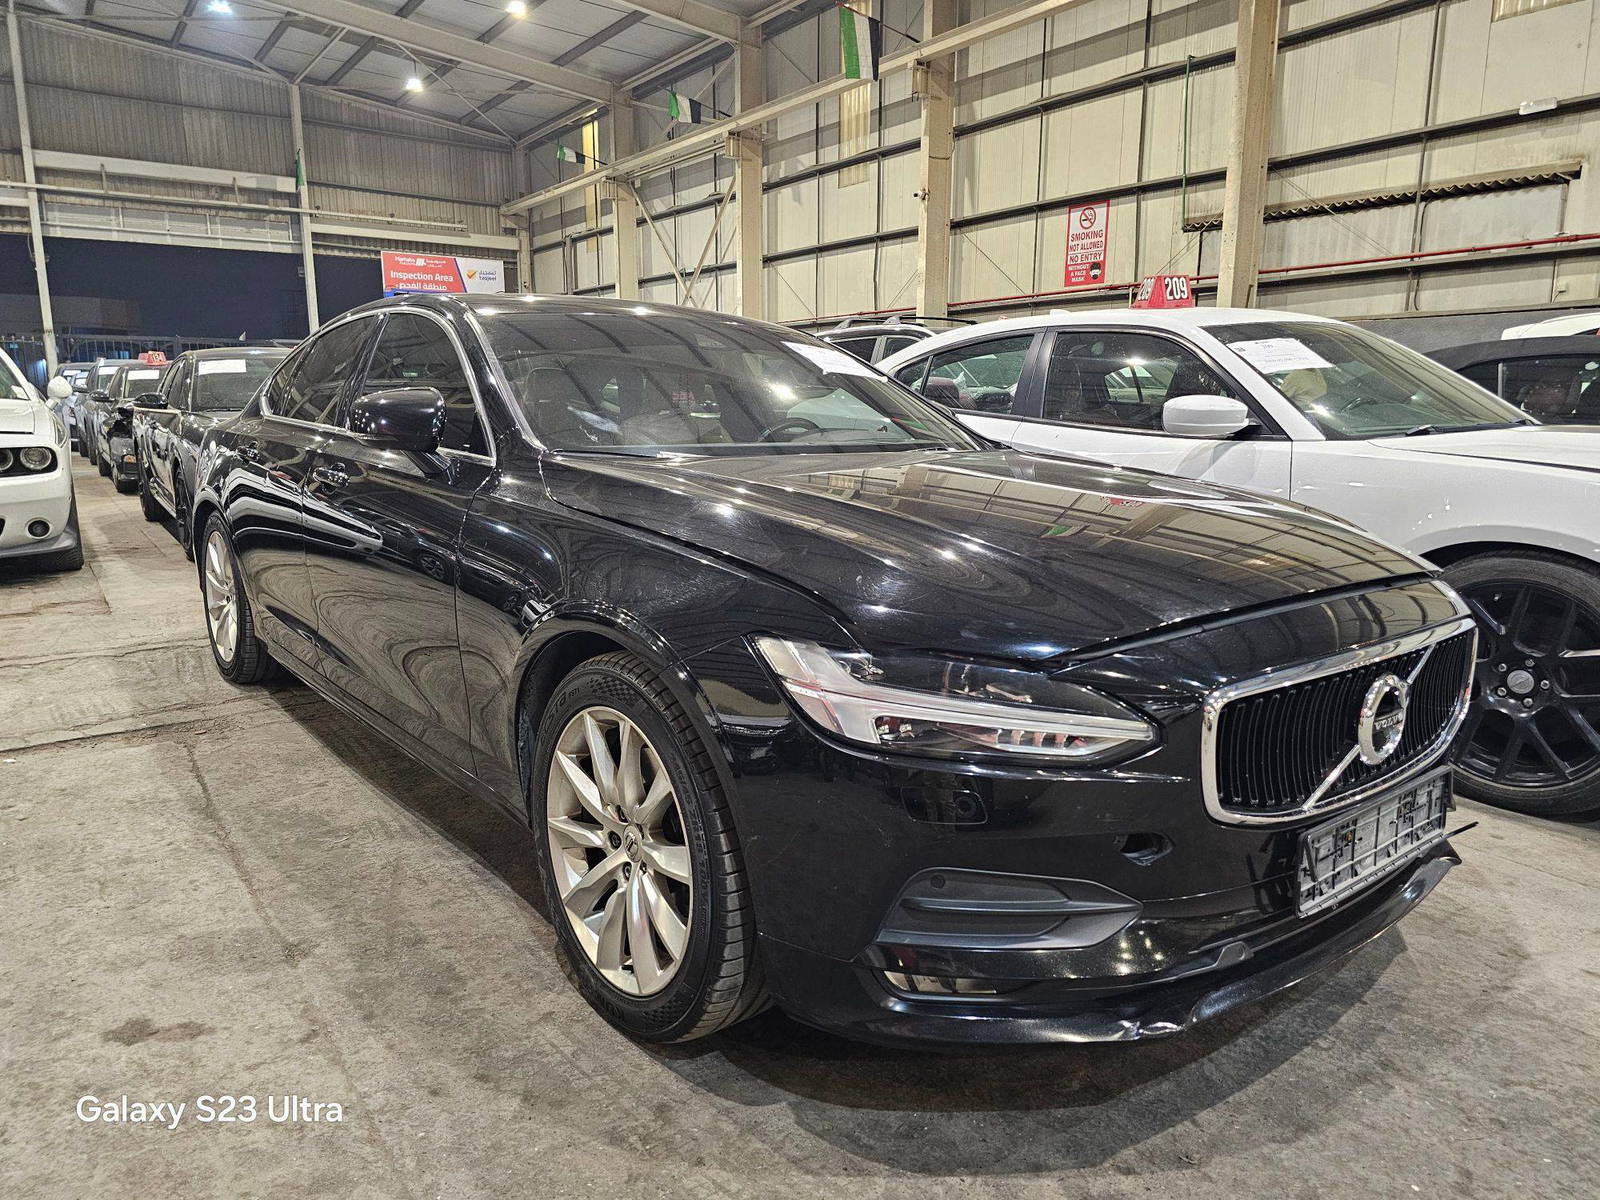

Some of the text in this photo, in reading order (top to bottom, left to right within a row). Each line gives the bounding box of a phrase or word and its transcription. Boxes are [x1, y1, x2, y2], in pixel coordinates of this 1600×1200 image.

[1070, 229, 1103, 242] SMOKING
[1069, 240, 1103, 252] NOT ALLOWED
[1069, 252, 1102, 263] NO ENTRY
[390, 270, 454, 282] Inspection Area
[1165, 277, 1188, 300] 209
[1374, 712, 1404, 730] VOLVO
